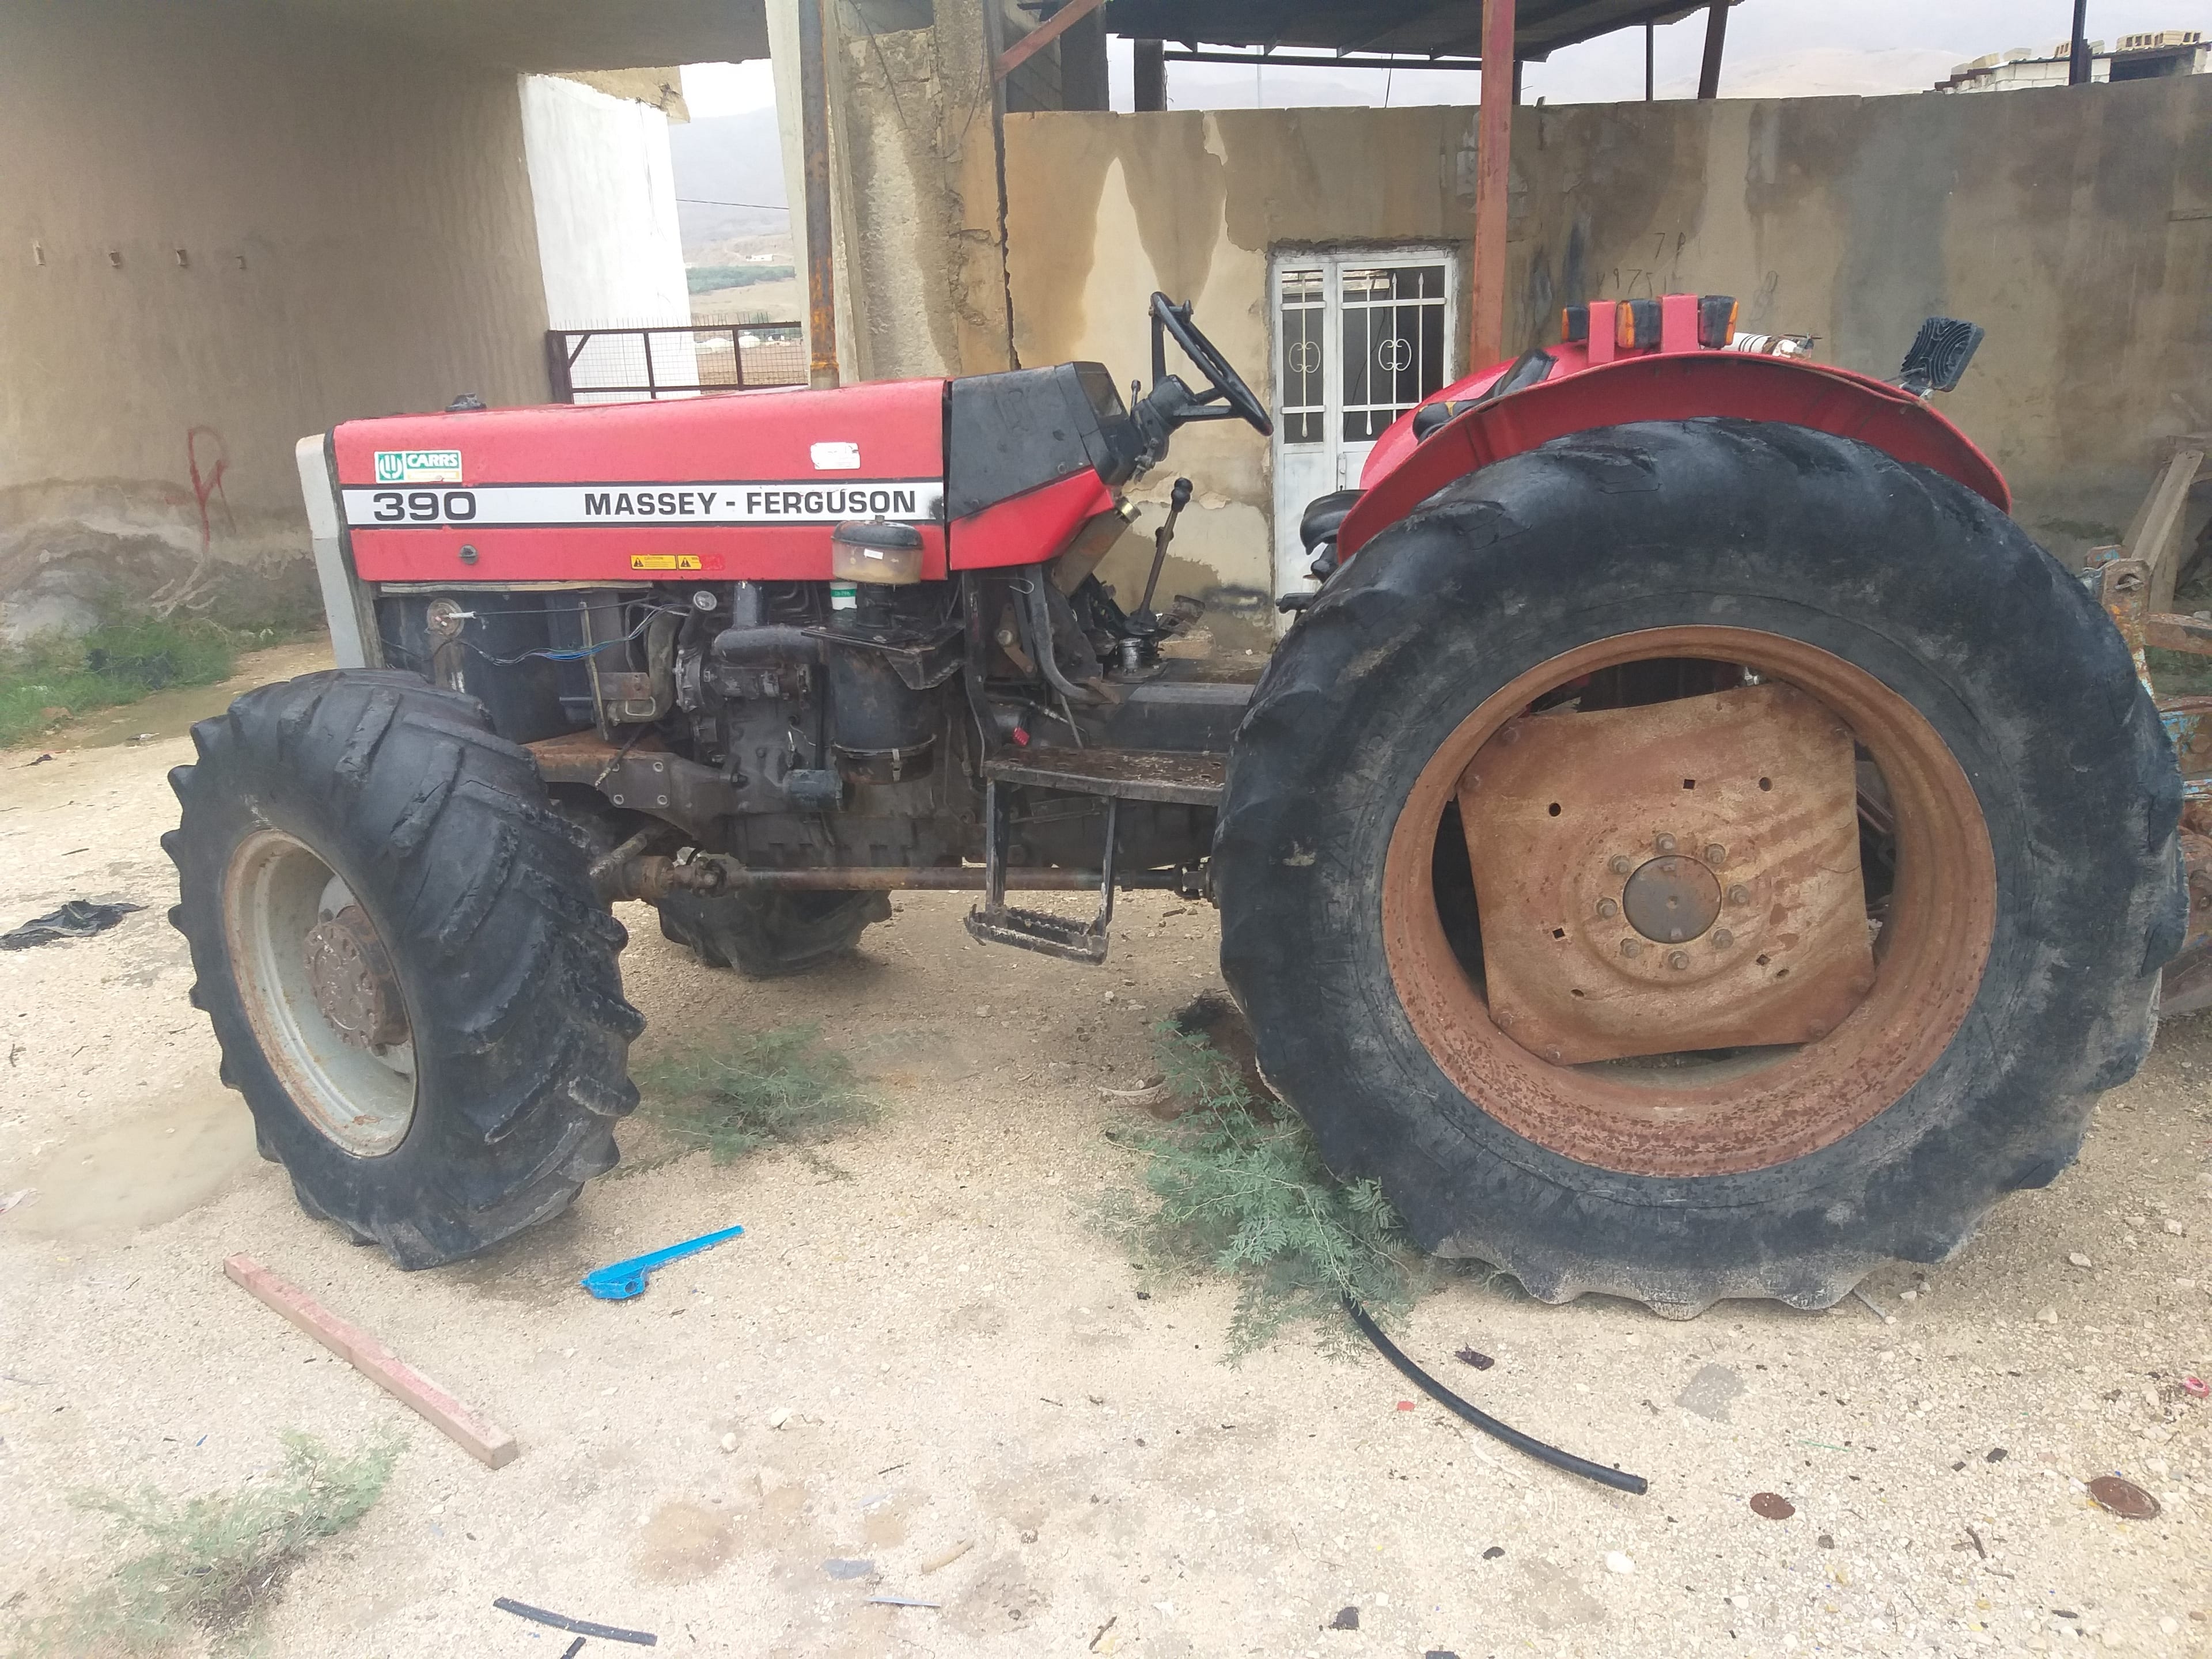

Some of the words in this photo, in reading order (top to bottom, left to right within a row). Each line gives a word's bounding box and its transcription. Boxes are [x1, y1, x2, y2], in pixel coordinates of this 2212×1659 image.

[407, 453, 459, 468] CARRS
[373, 491, 476, 521] 390
[584, 492, 718, 516] MASSEY
[746, 490, 916, 514] FERGUSON
